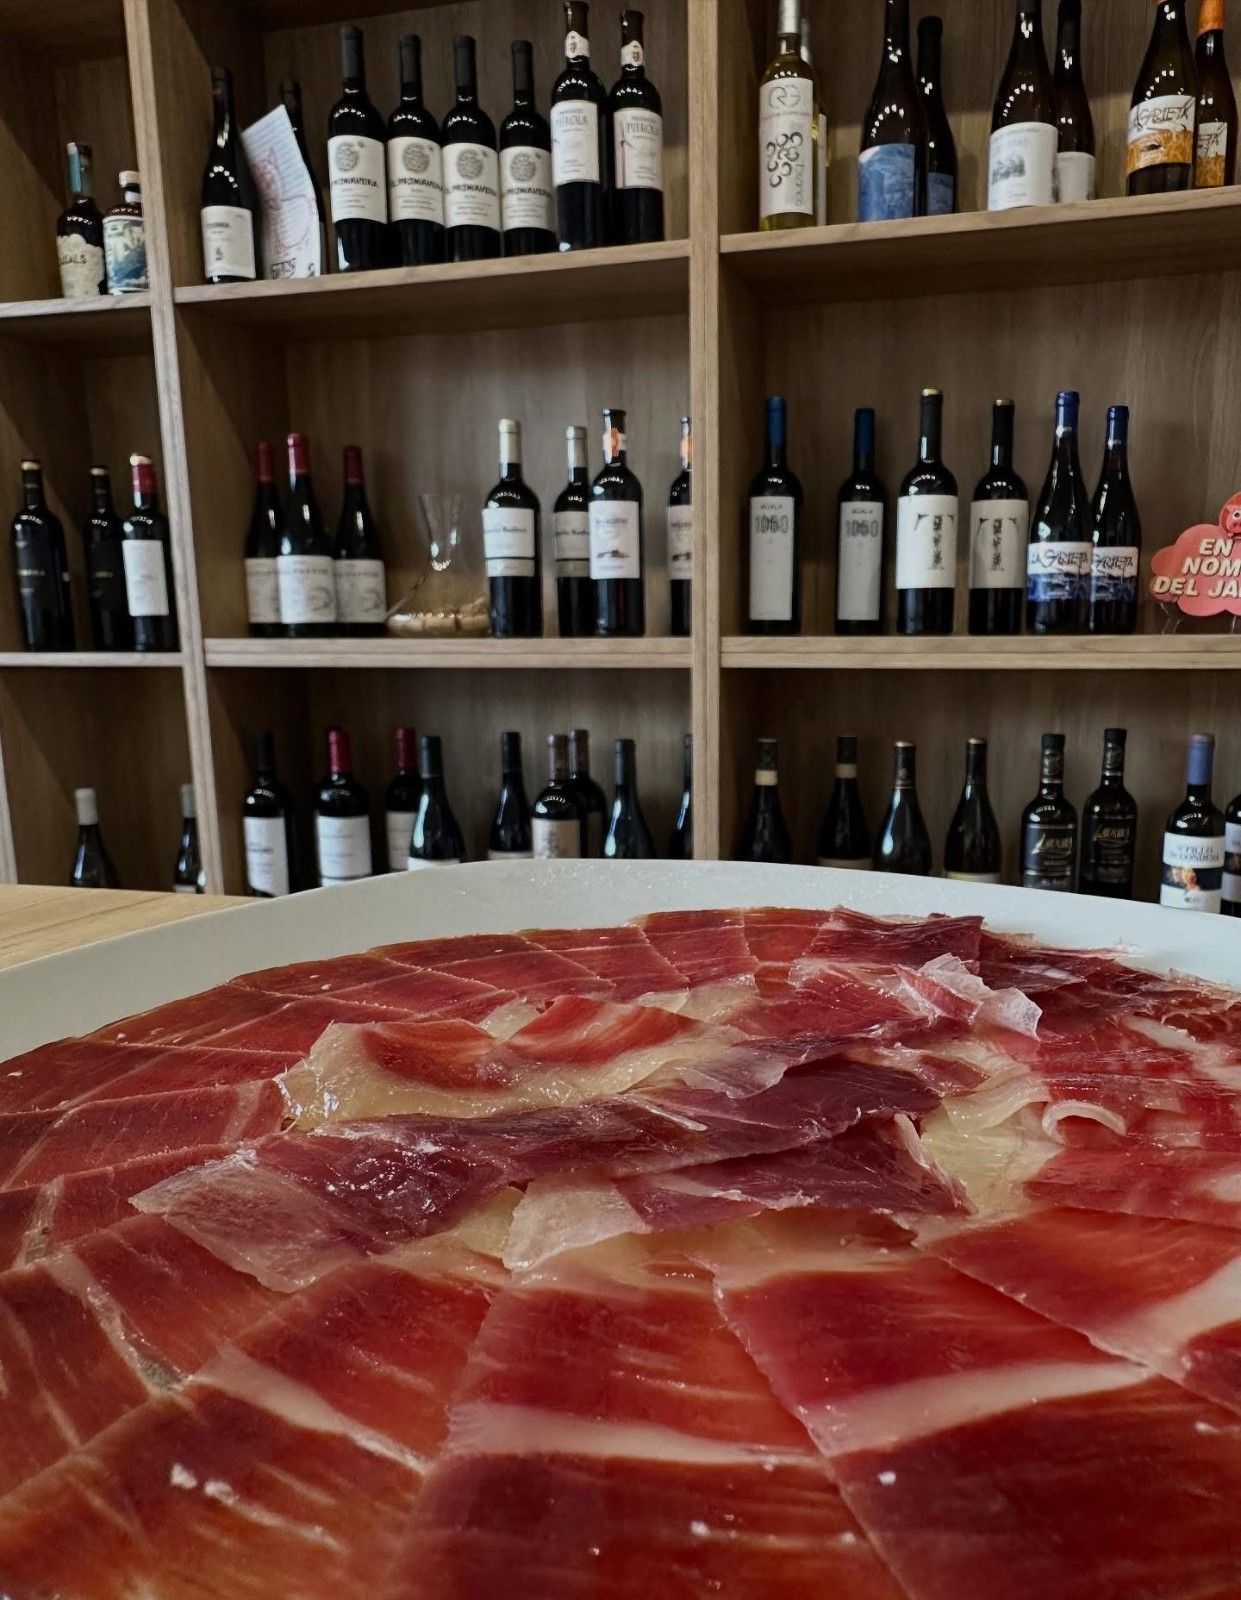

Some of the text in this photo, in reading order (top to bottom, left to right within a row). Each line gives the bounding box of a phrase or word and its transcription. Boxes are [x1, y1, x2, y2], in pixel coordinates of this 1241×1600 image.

[1200, 538, 1234, 558] EN
[1182, 556, 1241, 577] NOM
[1153, 575, 1241, 598] DEL JA
